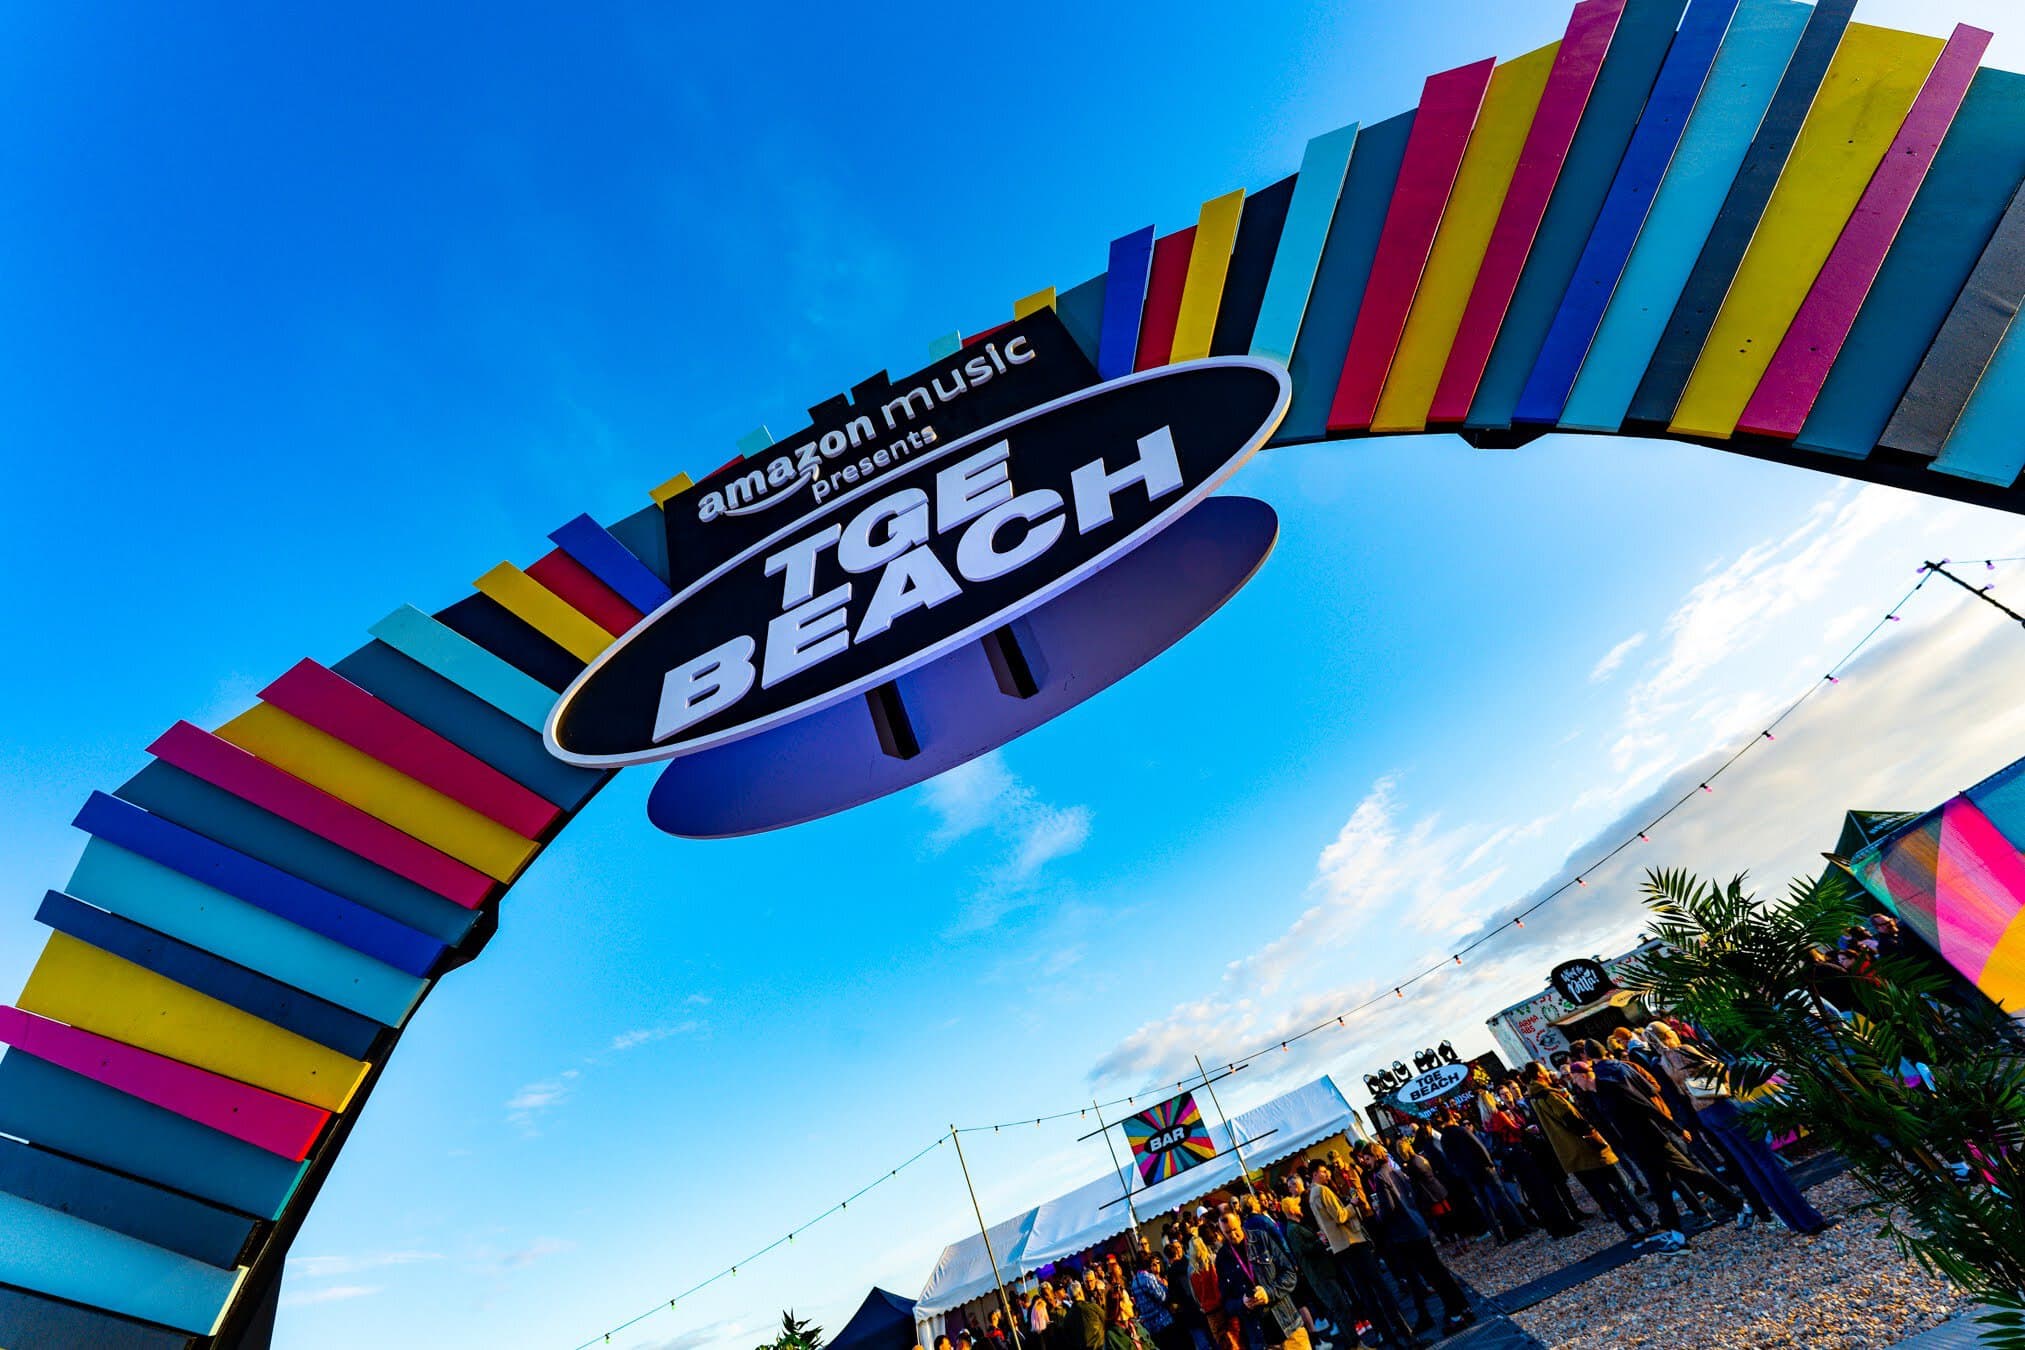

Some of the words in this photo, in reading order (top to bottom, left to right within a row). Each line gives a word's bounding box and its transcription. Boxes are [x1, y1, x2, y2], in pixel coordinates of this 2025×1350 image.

[698, 415, 877, 523] amazon
[881, 335, 1036, 429] music
[811, 425, 938, 504] presents
[764, 438, 1013, 611] TGE
[652, 424, 1184, 744] BEACH
[1410, 1072, 1460, 1100] BEACH
[1416, 1070, 1442, 1087] TGE
[1150, 1127, 1185, 1152] BAR
